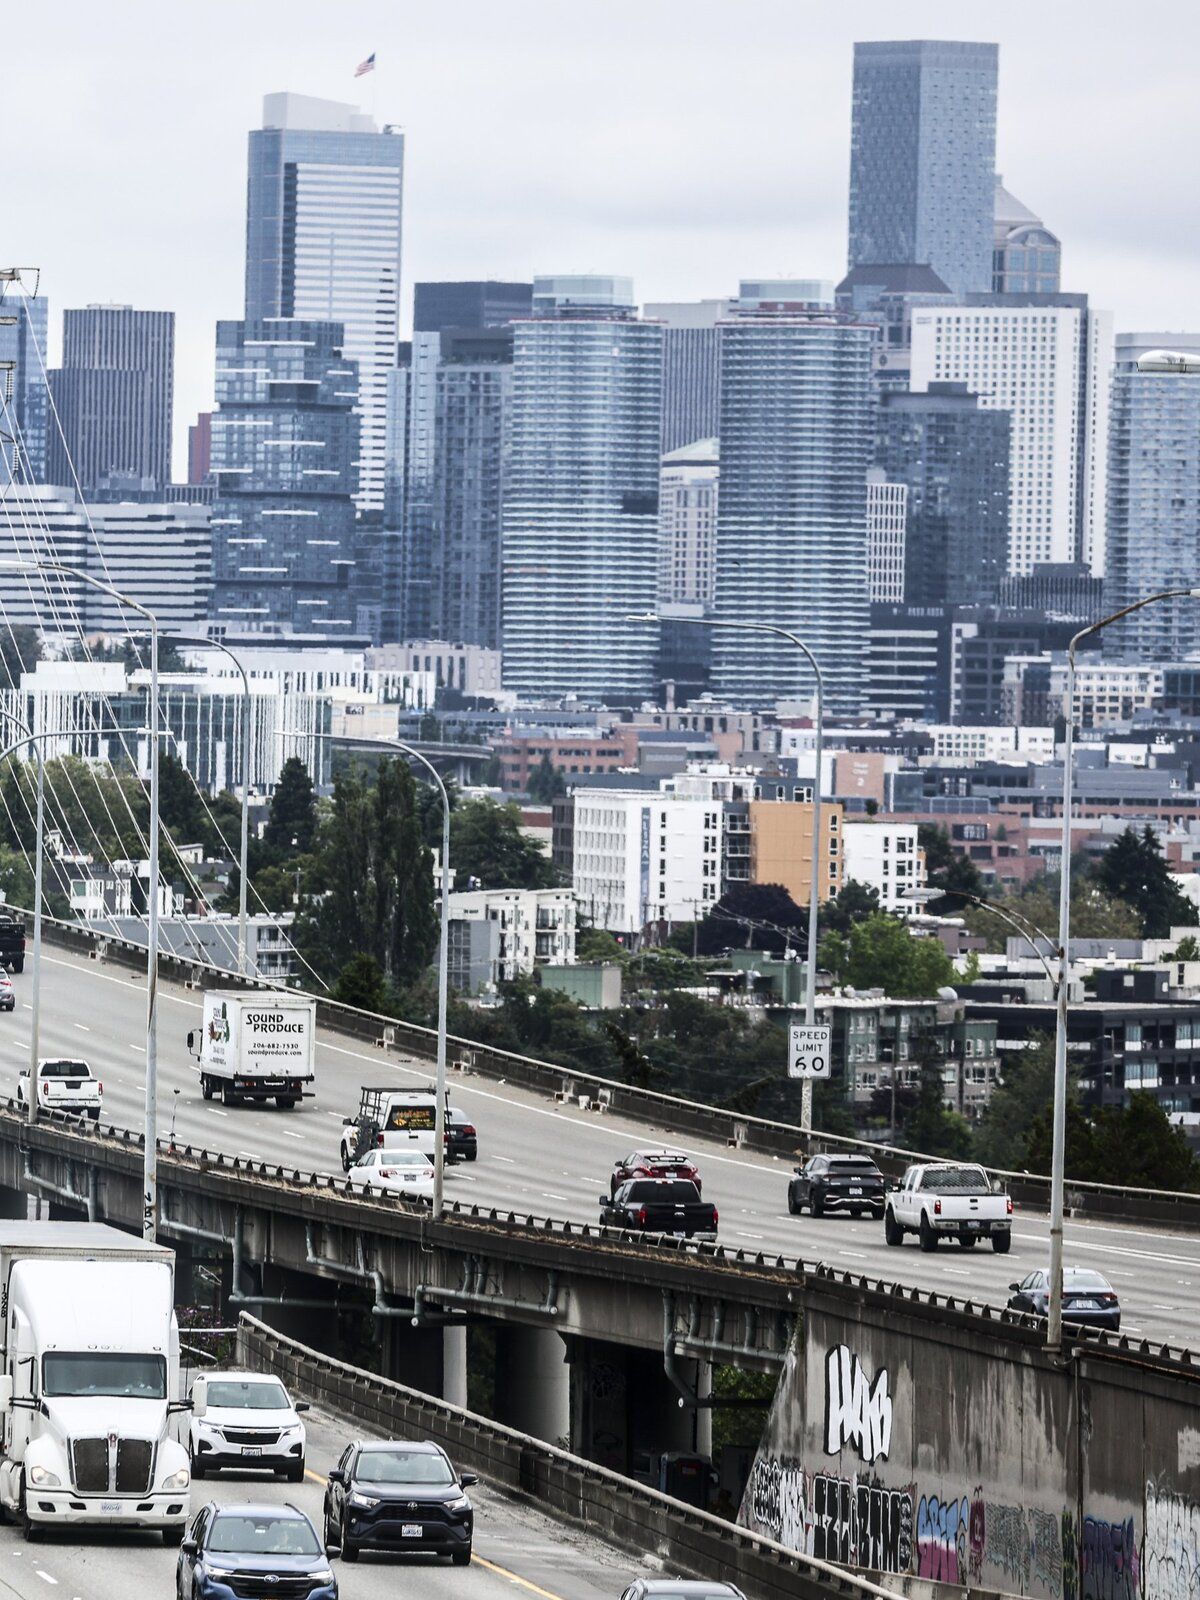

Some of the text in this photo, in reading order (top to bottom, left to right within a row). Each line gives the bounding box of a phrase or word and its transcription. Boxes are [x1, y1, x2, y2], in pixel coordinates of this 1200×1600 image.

[246, 1013, 284, 1025] SOUND
[253, 1023, 304, 1033] PRODUCE
[793, 1031, 828, 1040] SPEED
[796, 1044, 823, 1052] LIMIT
[795, 1056, 824, 1072] 60
